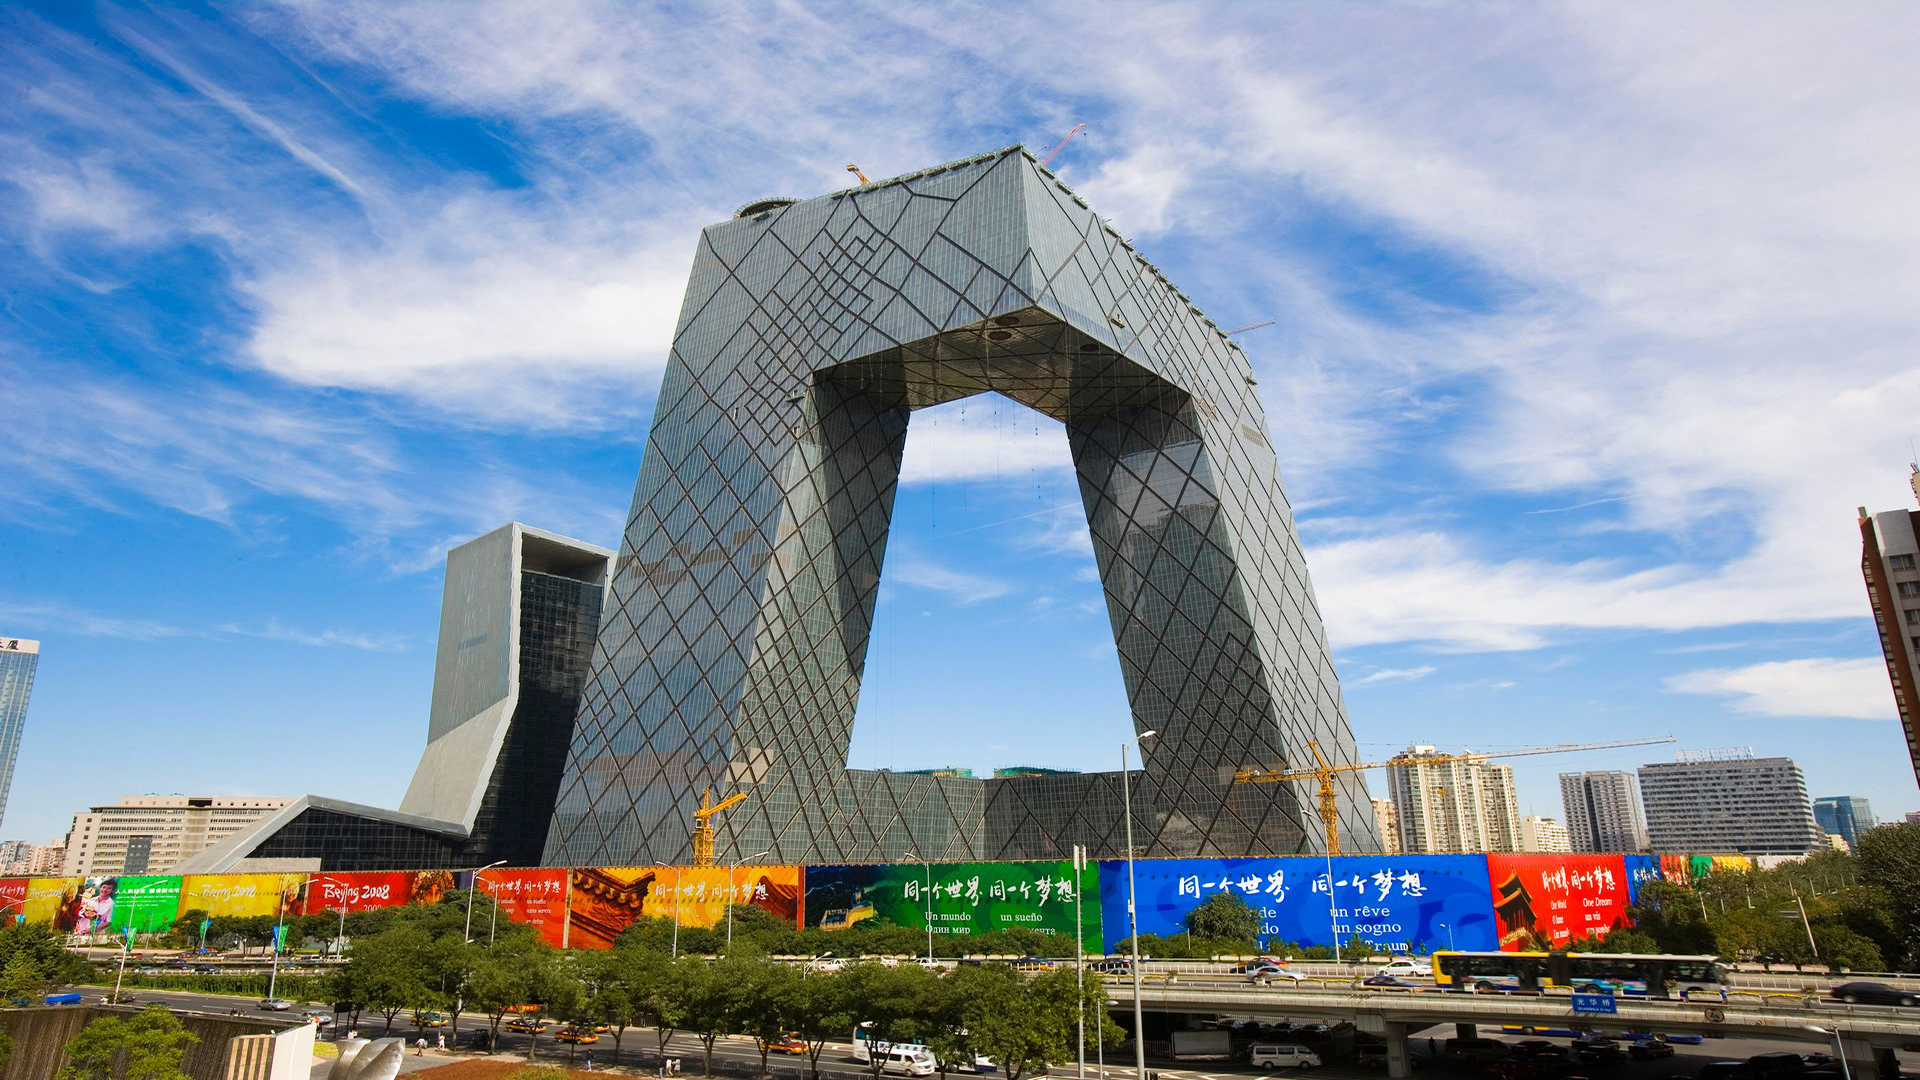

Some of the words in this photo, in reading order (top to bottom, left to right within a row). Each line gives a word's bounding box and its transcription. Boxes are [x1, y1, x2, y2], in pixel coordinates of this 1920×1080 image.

[488, 879, 522, 895] 同一个世界
[524, 878, 561, 895] 同一个梦想
[1179, 869, 1290, 903] 同一个世界
[1312, 867, 1427, 902] 同一个梦想
[1542, 866, 1570, 896] 同一个世界
[1571, 866, 1616, 895] 同一个梦想
[201, 884, 231, 902] Beijing
[232, 885, 256, 898] 2008
[322, 883, 359, 904] Beijing
[361, 884, 390, 900] 2008
[656, 881, 707, 902] 同一个世界
[712, 881, 768, 903] 同一个梦想
[904, 875, 982, 907] 同一个世界
[989, 874, 1077, 907] 同一个梦想
[1583, 897, 1594, 907] One
[1595, 897, 1612, 907] Dream
[925, 911, 939, 922] Un
[940, 911, 972, 922] mundo
[1000, 914, 1012, 922] un
[1014, 912, 1043, 922] sueño
[1329, 907, 1349, 918] un
[1354, 905, 1391, 918] rêve
[952, 926, 971, 935] мир
[1332, 924, 1351, 934] un
[1356, 923, 1402, 937] sogno
[1577, 998, 1611, 1007] 光华桥
